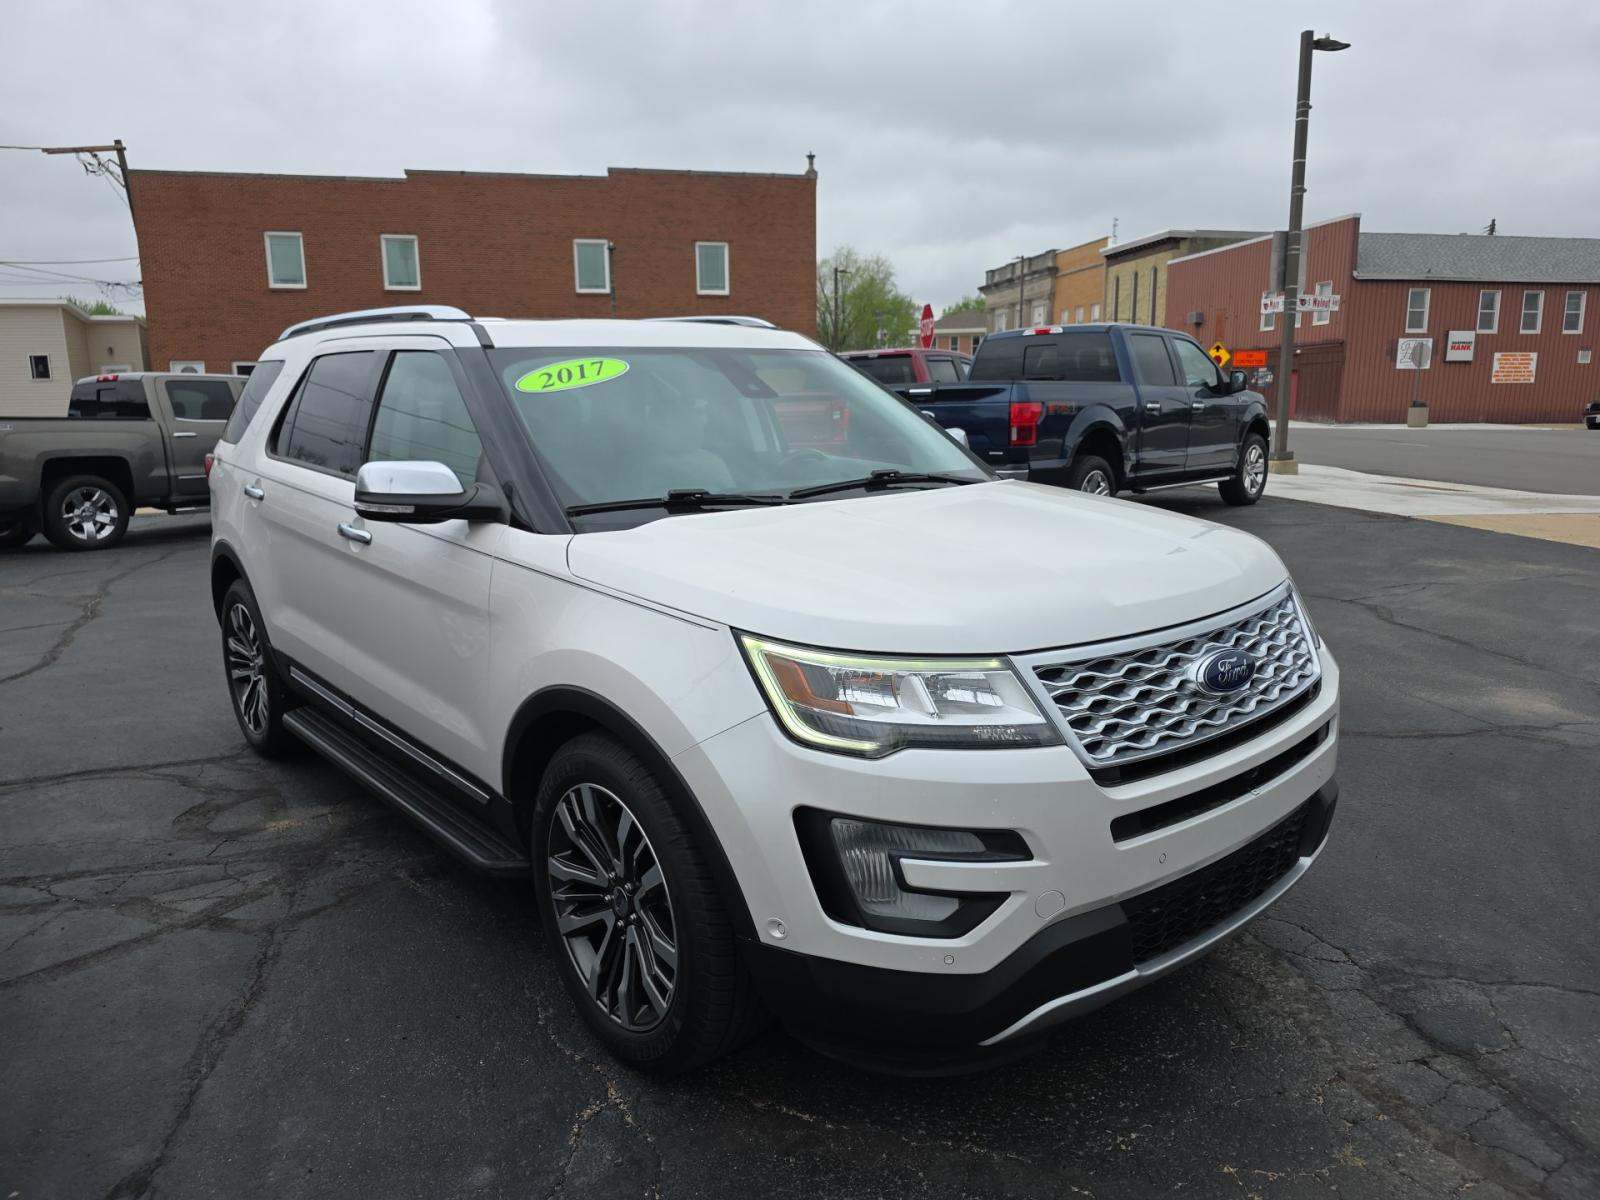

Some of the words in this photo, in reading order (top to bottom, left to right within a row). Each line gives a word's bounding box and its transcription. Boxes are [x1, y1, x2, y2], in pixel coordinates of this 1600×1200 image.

[921, 318, 934, 337] STOP
[538, 361, 604, 390] 2017
[1217, 656, 1248, 682] Ford
